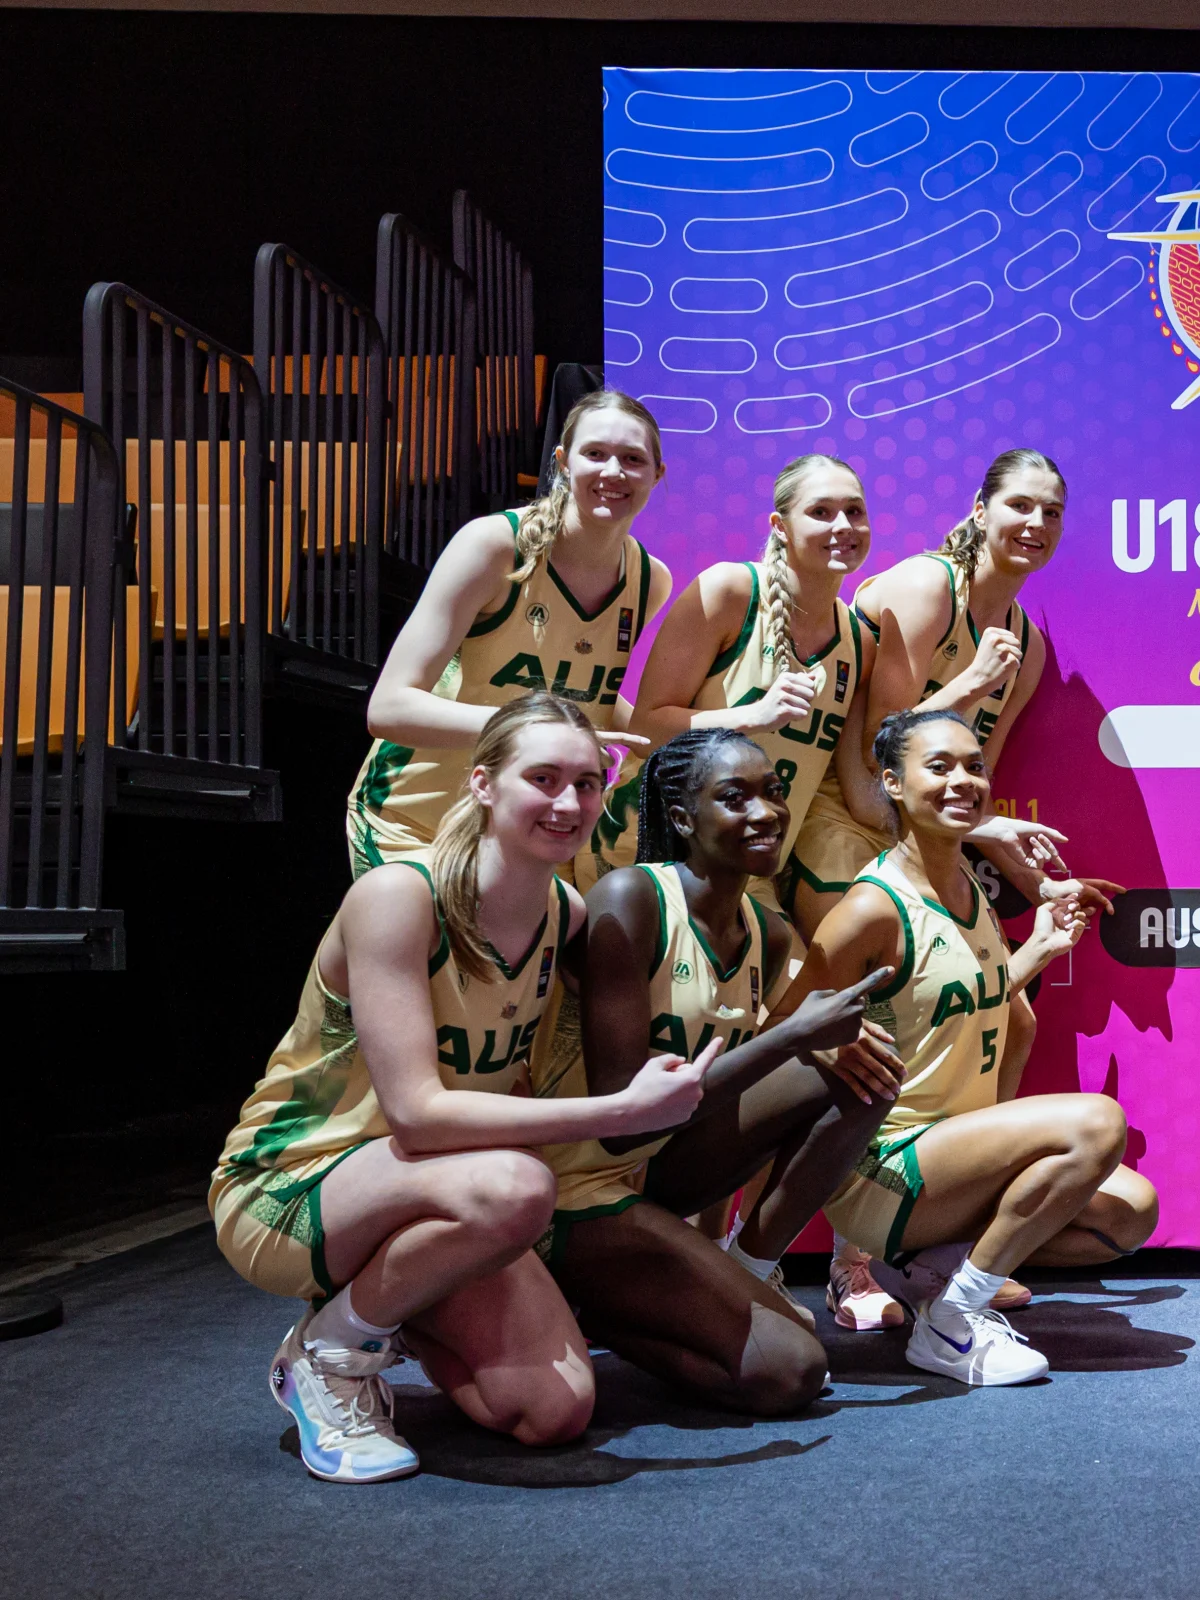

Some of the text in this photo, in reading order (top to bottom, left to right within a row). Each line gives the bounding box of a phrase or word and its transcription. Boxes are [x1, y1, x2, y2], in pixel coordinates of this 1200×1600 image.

[931, 964, 1010, 1028] AU
[650, 1012, 754, 1061] AU
[980, 1027, 998, 1075] 5
